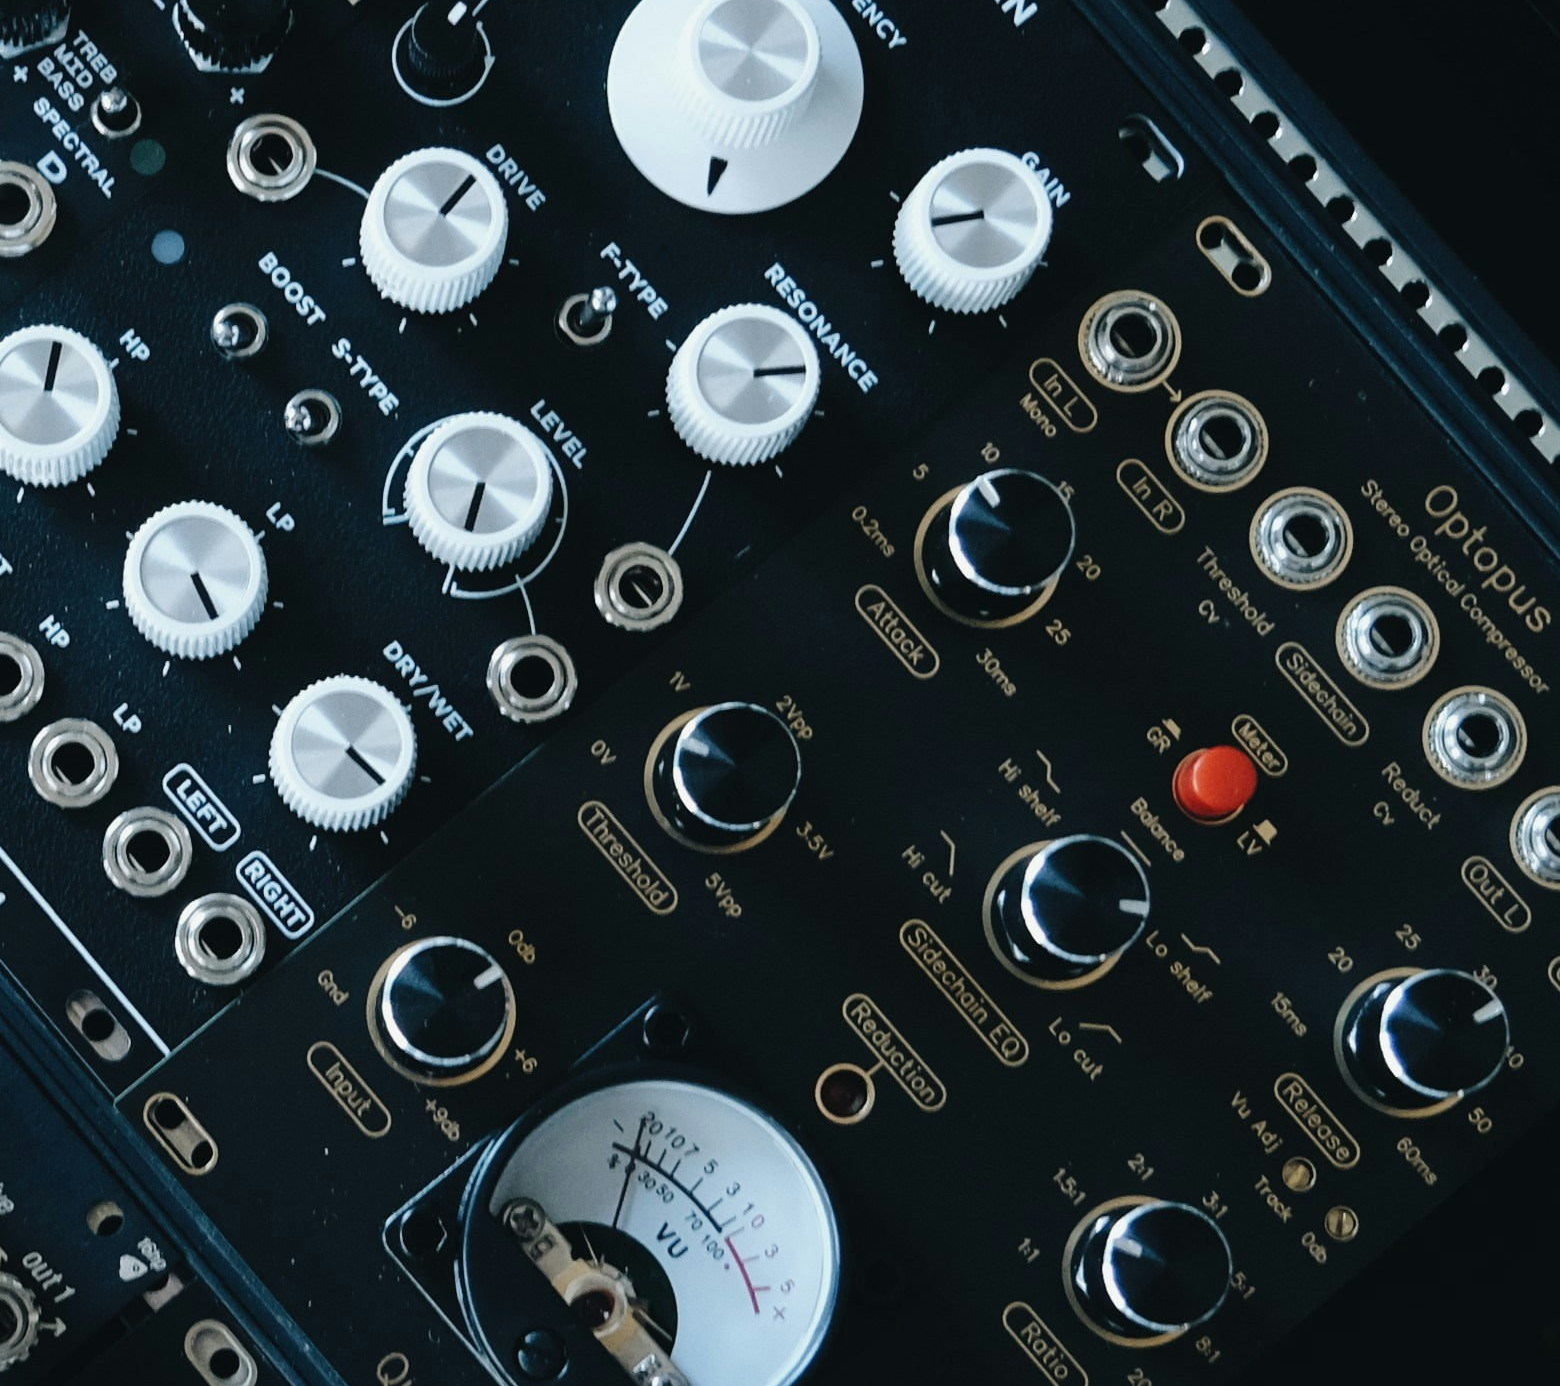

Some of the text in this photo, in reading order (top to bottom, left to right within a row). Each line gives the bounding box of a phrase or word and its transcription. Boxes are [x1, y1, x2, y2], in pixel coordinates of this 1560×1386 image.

[35, 55, 86, 114] BASS
[51, 42, 94, 91] MID
[70, 28, 119, 86] TREB
[31, 95, 116, 201] SPECTRAL
[483, 142, 547, 213] DRIVE
[1012, 150, 1072, 209] GAIN
[256, 250, 327, 327] BOOST
[597, 240, 670, 322] F-TYPE
[117, 327, 151, 363] HP
[762, 261, 880, 395] RESONANCE
[329, 336, 401, 418] S-TYPE
[527, 397, 588, 471] LEVEL
[263, 500, 296, 533] LP
[1195, 544, 1277, 638] Threshold
[1358, 478, 1551, 695] Stereo Optical Compressor
[1422, 483, 1553, 635] Optopus
[864, 600, 925, 668] Attack
[380, 639, 475, 743] DRY/WET
[1283, 650, 1358, 745] Sidechain
[1229, 720, 1281, 778] Meter
[174, 777, 229, 836] LEFT
[1128, 795, 1186, 864] Balance
[1379, 760, 1442, 832] Reduct
[578, 804, 676, 912] Threshold
[242, 858, 308, 937] RIGHT
[901, 921, 1021, 1066] Sidechain EQ
[323, 1060, 372, 1119] Input
[849, 1000, 936, 1112] Reduction
[1280, 1078, 1351, 1170] Release
[654, 1220, 689, 1260] VU
[1018, 1319, 1070, 1381] Ratio
